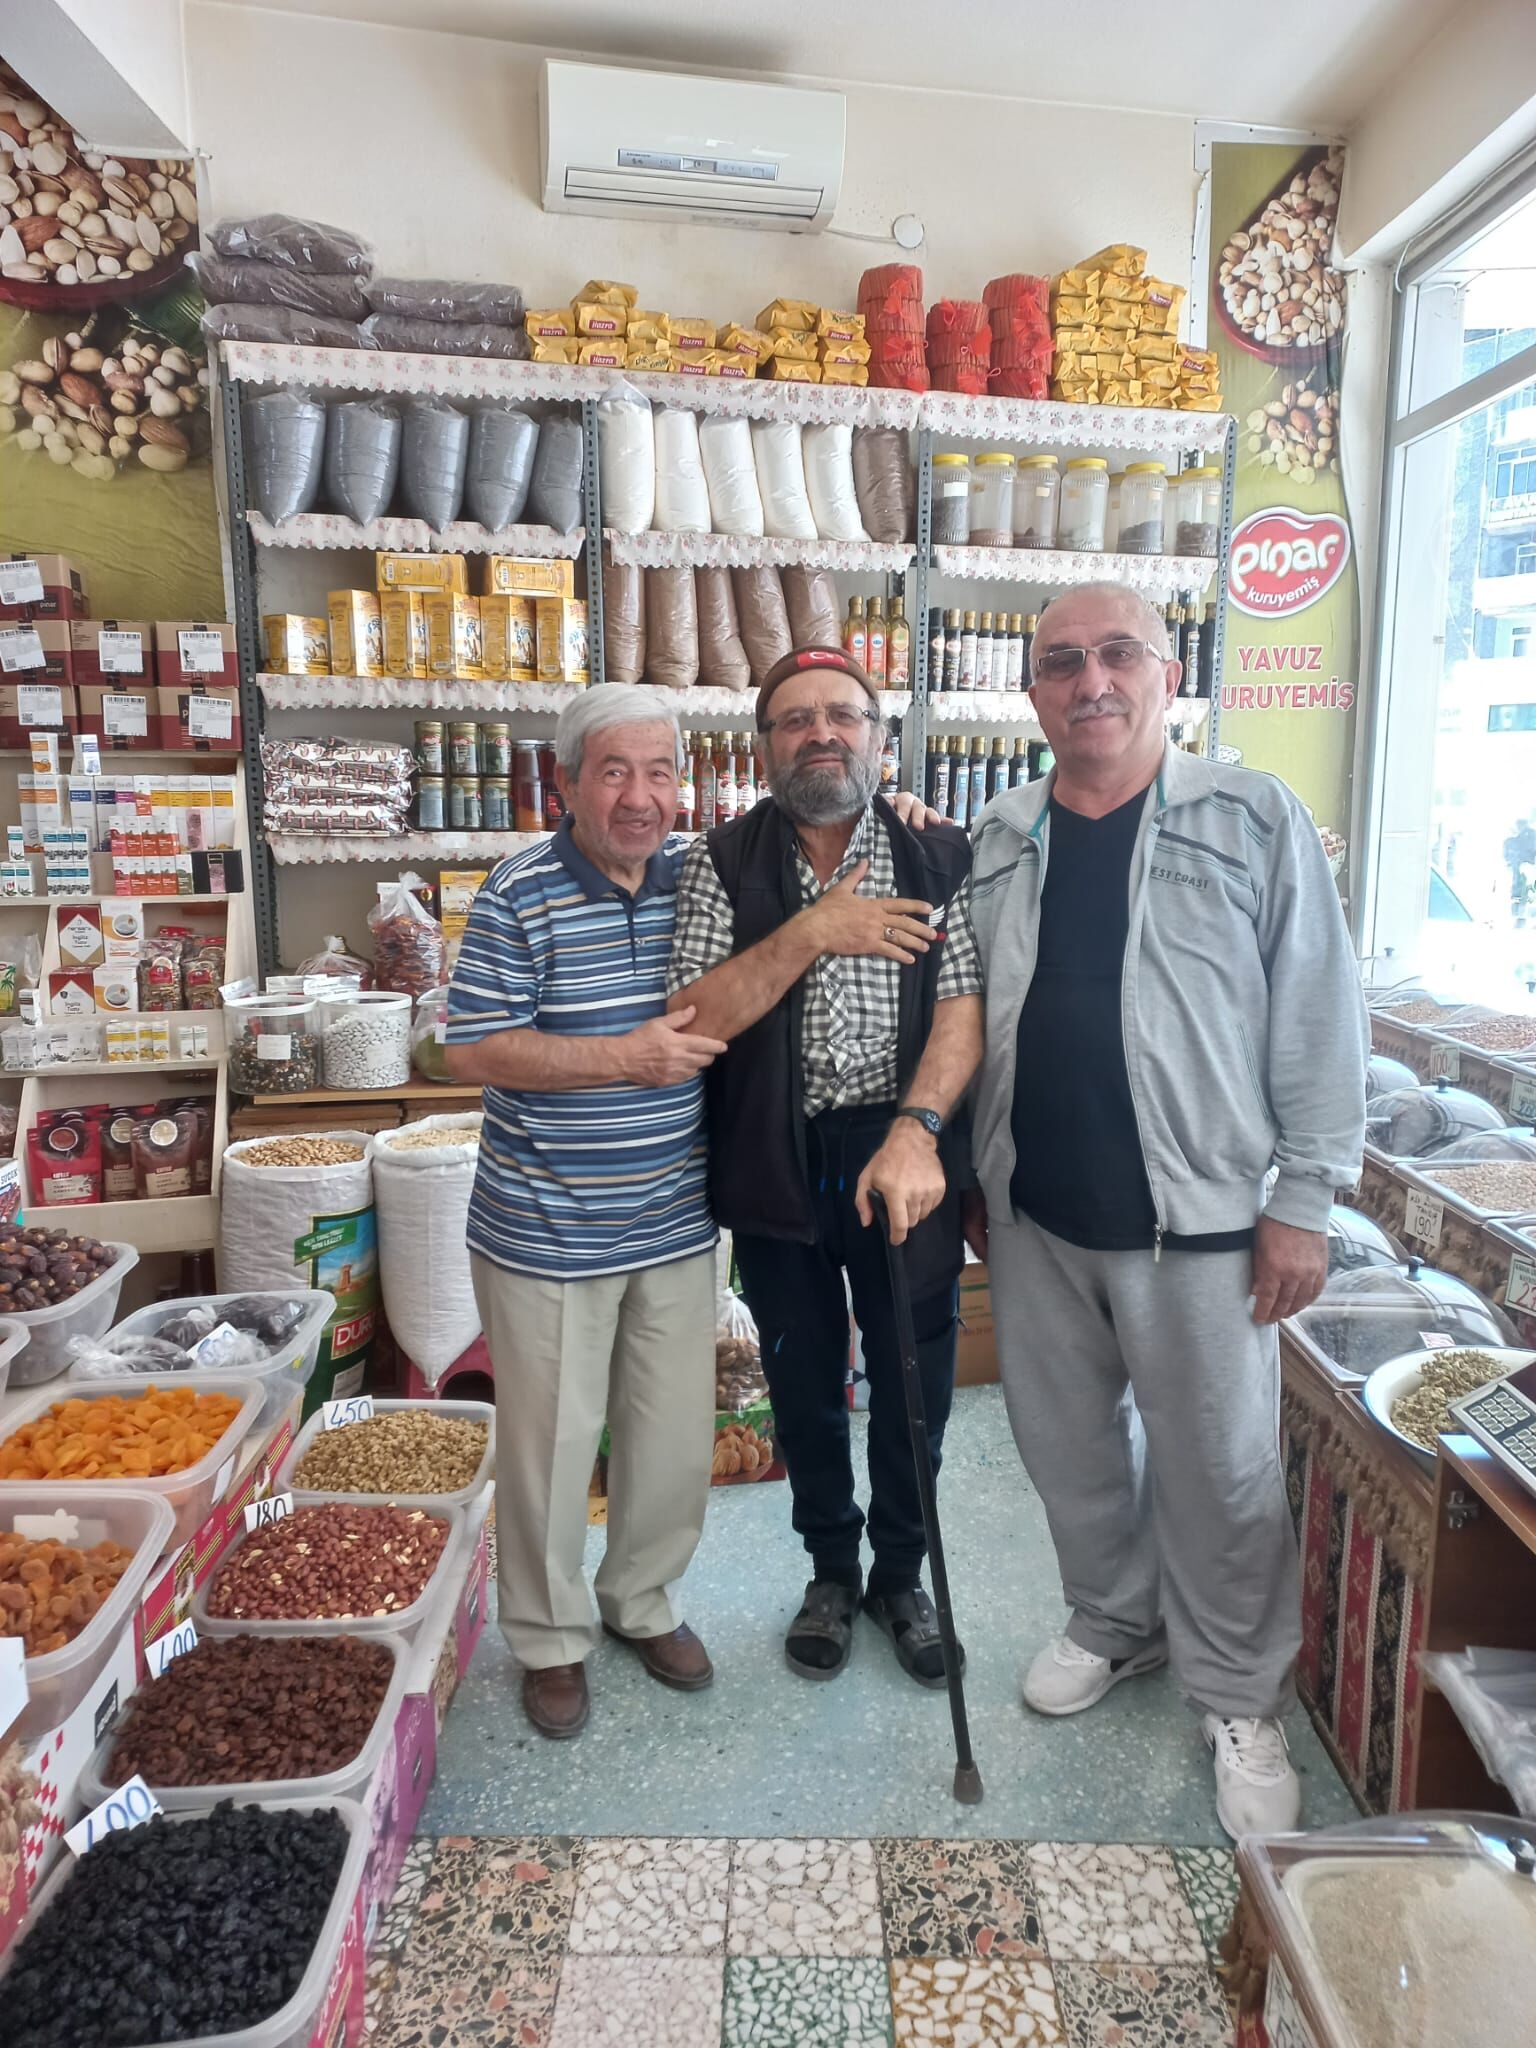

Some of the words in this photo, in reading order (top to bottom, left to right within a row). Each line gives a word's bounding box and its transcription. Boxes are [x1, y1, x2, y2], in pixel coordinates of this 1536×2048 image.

[591, 321, 613, 330] Hazra
[592, 356, 614, 365] Hazra
[1247, 575, 1320, 609] kuruyemiş
[1238, 646, 1324, 672] YAVUZ
[1220, 678, 1356, 712] URUYEMİŞ
[1149, 865, 1172, 879] EST
[1174, 872, 1209, 889] COAST
[329, 1399, 371, 1427] 450
[256, 1498, 287, 1528] 180
